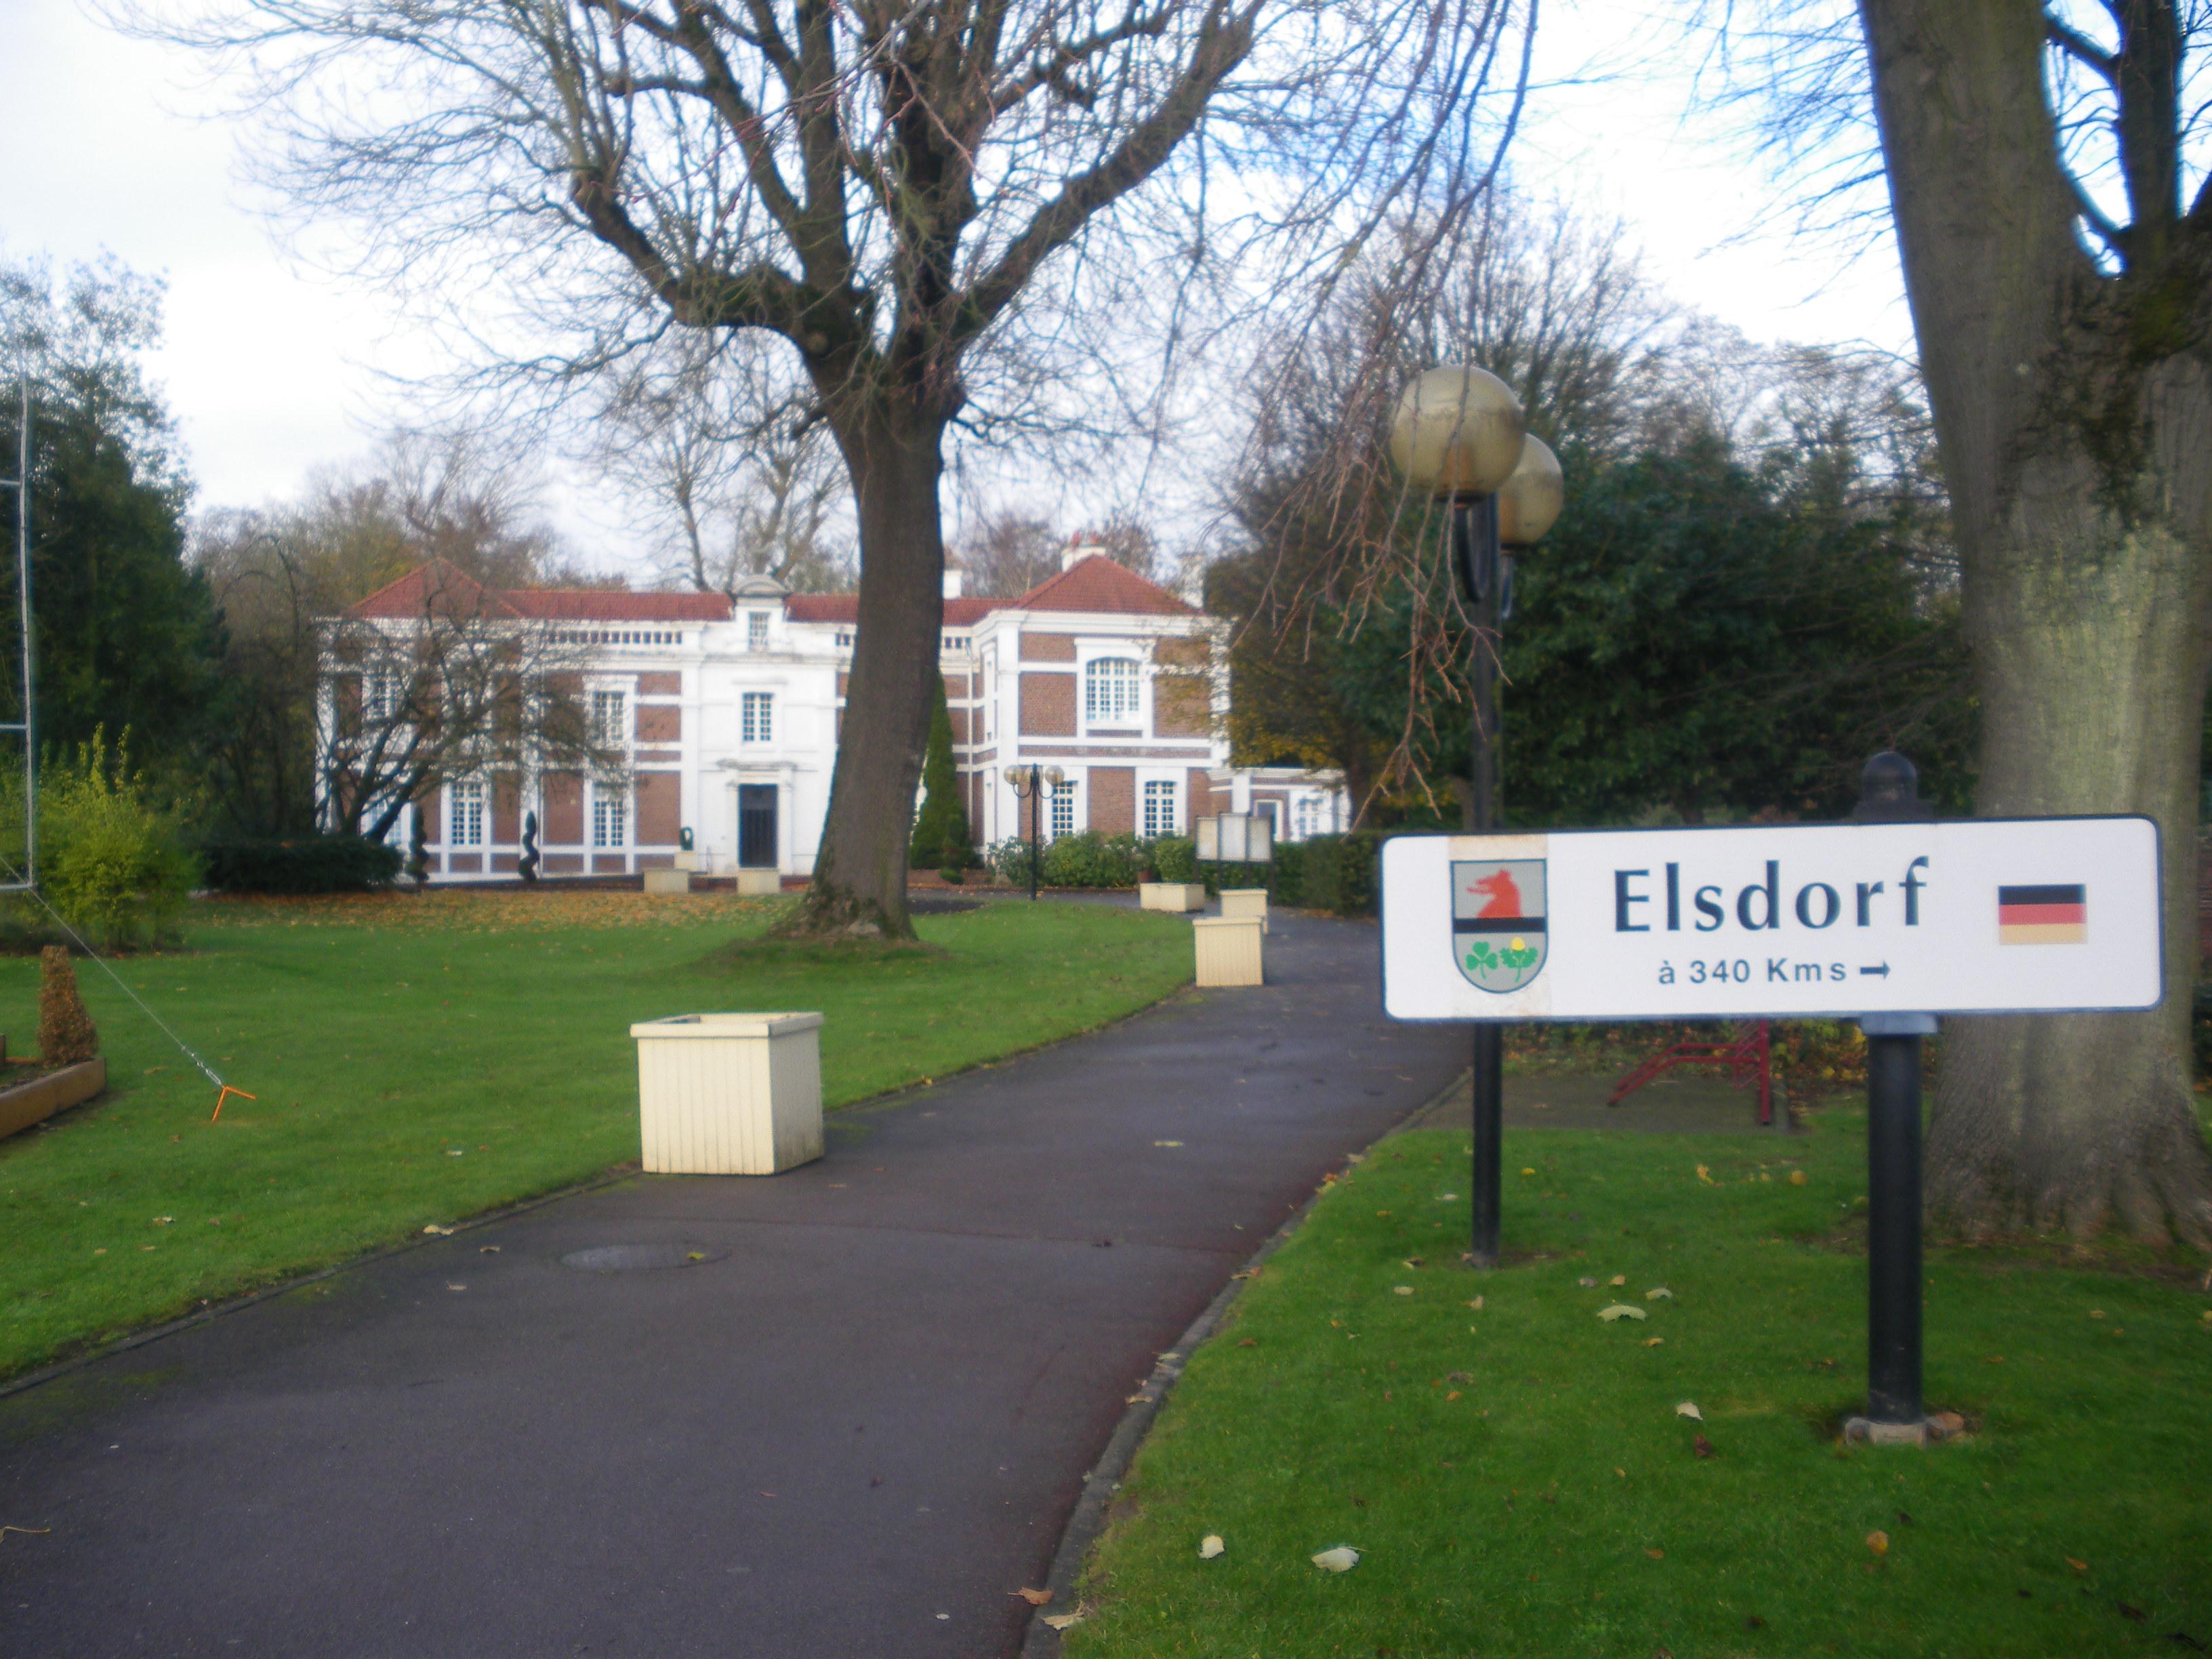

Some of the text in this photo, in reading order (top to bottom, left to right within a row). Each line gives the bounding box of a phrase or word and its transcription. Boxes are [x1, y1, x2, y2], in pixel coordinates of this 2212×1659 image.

[1613, 855, 1929, 933] Elsdorf
[1658, 958, 1847, 985] à 340 Kms
